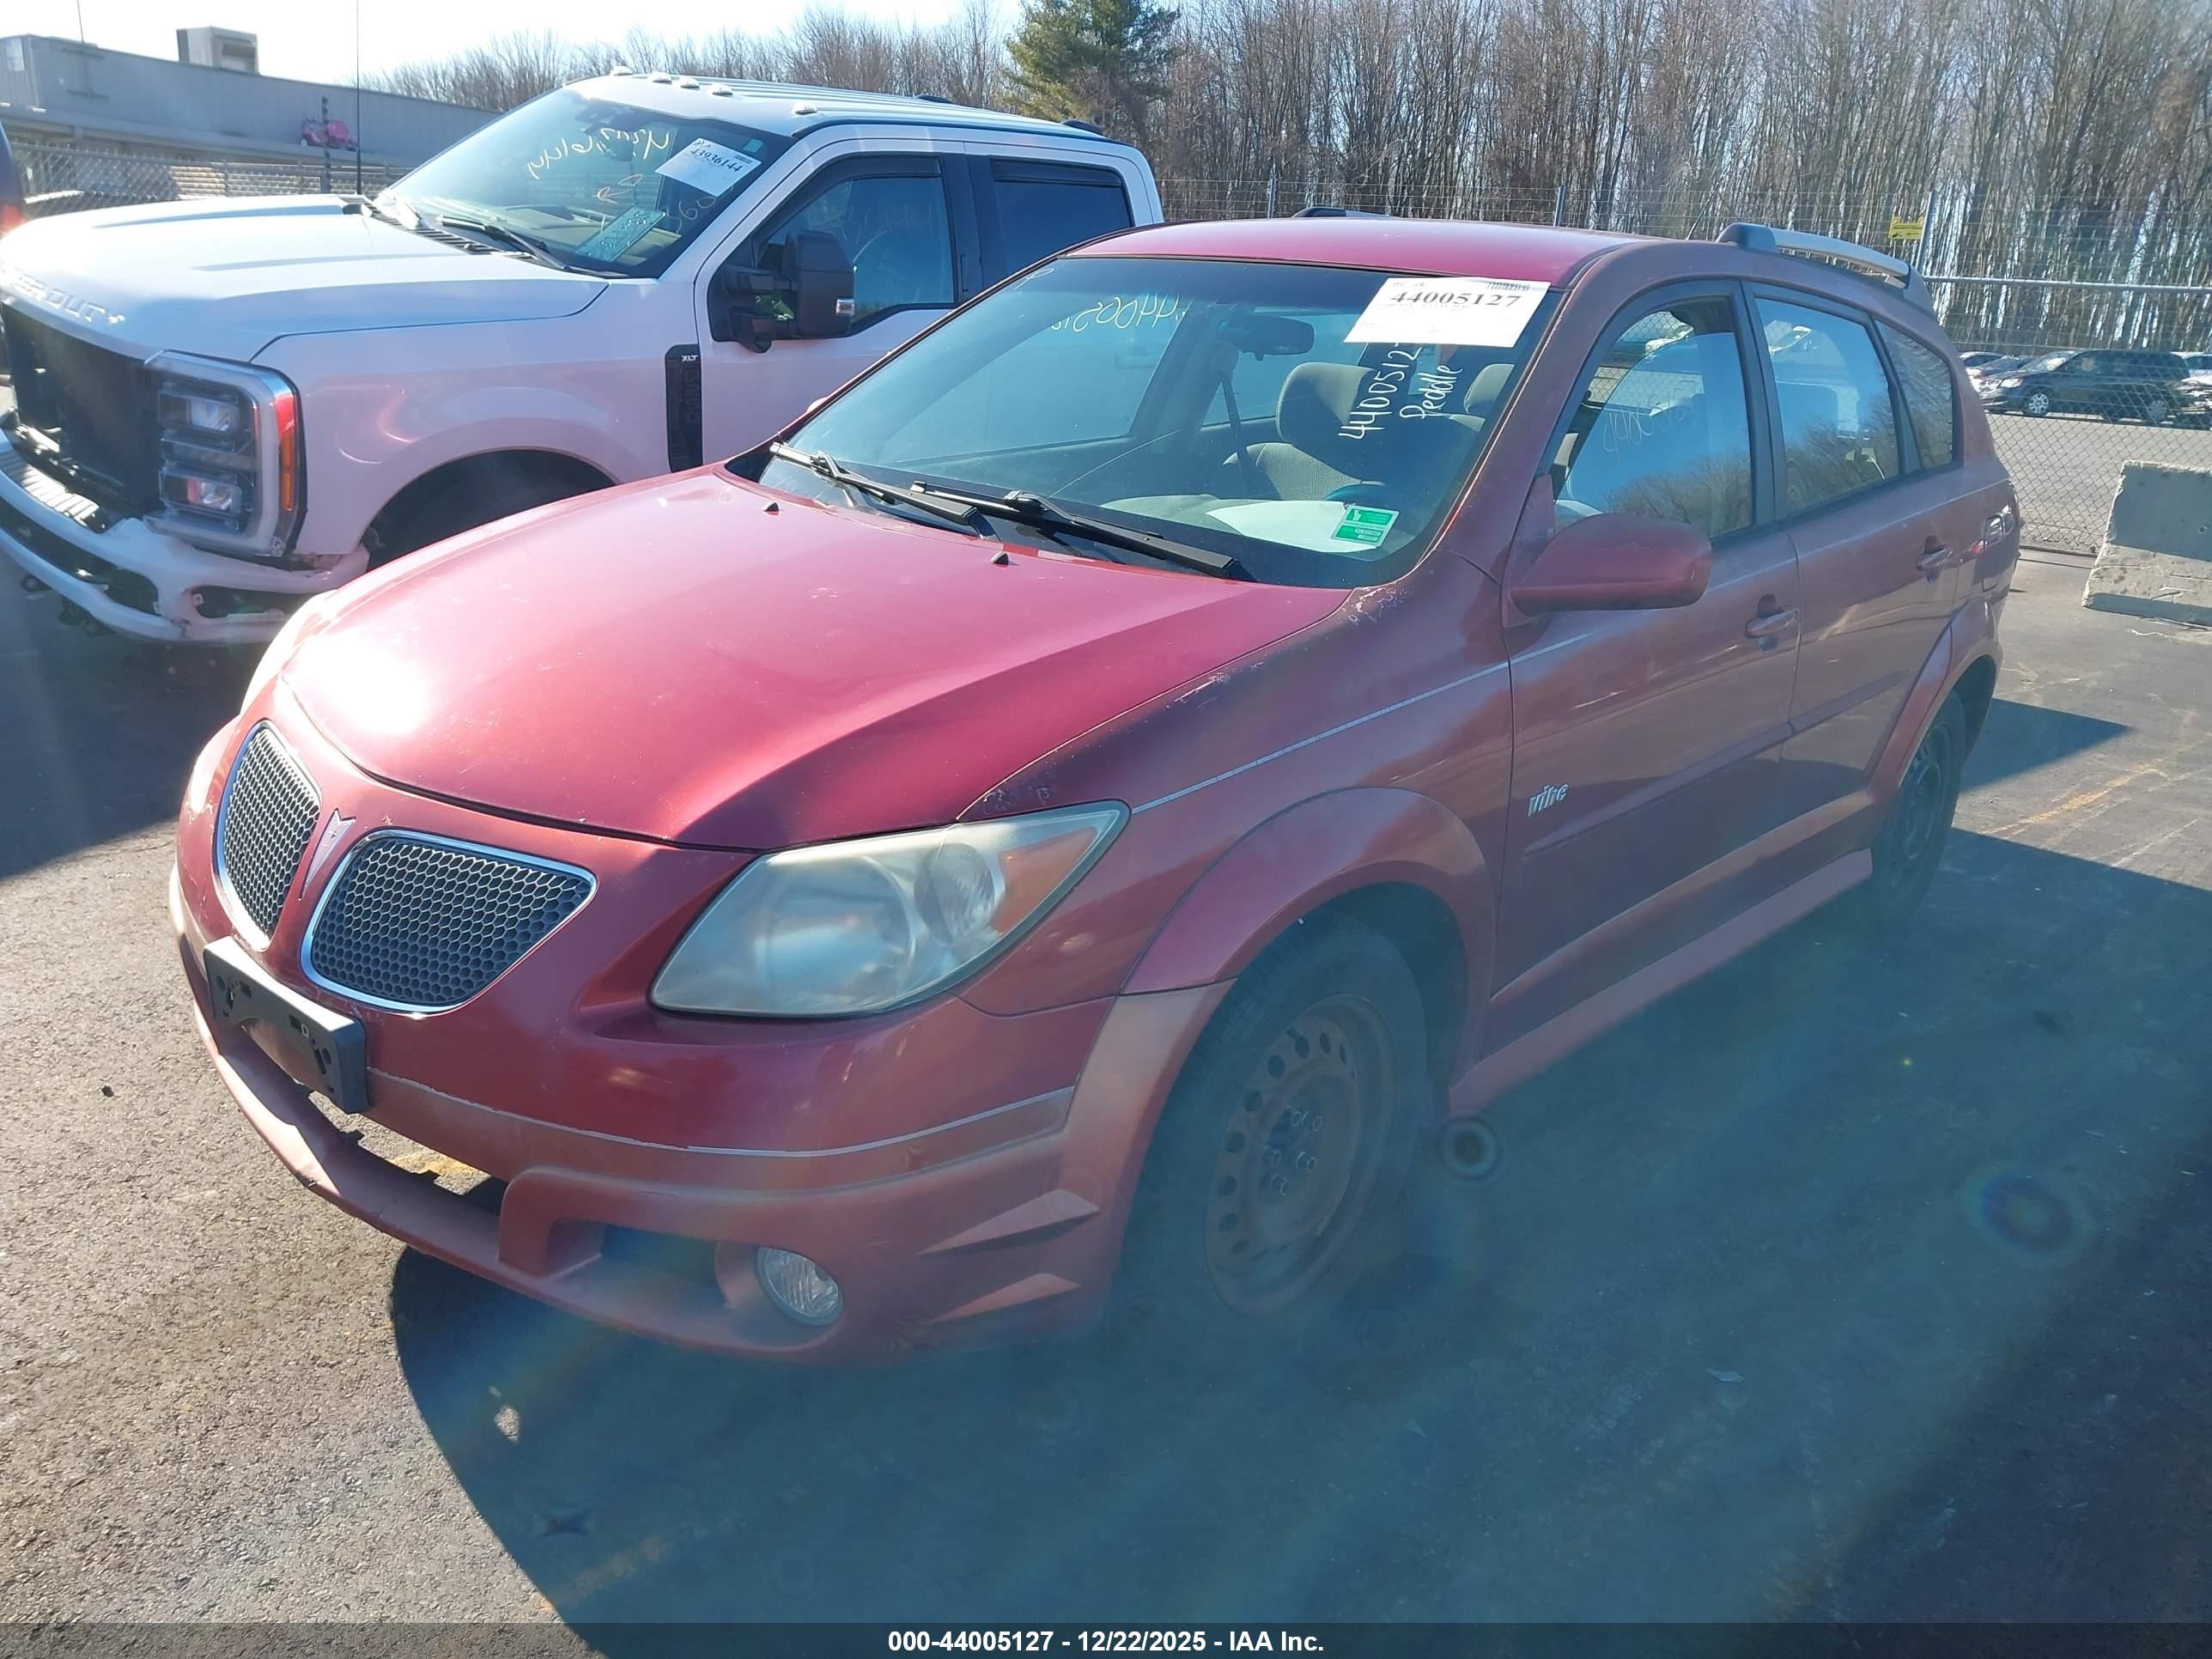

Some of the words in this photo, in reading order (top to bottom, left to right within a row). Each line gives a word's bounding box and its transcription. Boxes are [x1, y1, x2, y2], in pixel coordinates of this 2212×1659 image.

[1390, 291, 1522, 307] 44005127
[1338, 342, 1422, 440] 4400512
[1399, 364, 1464, 419] Peddle
